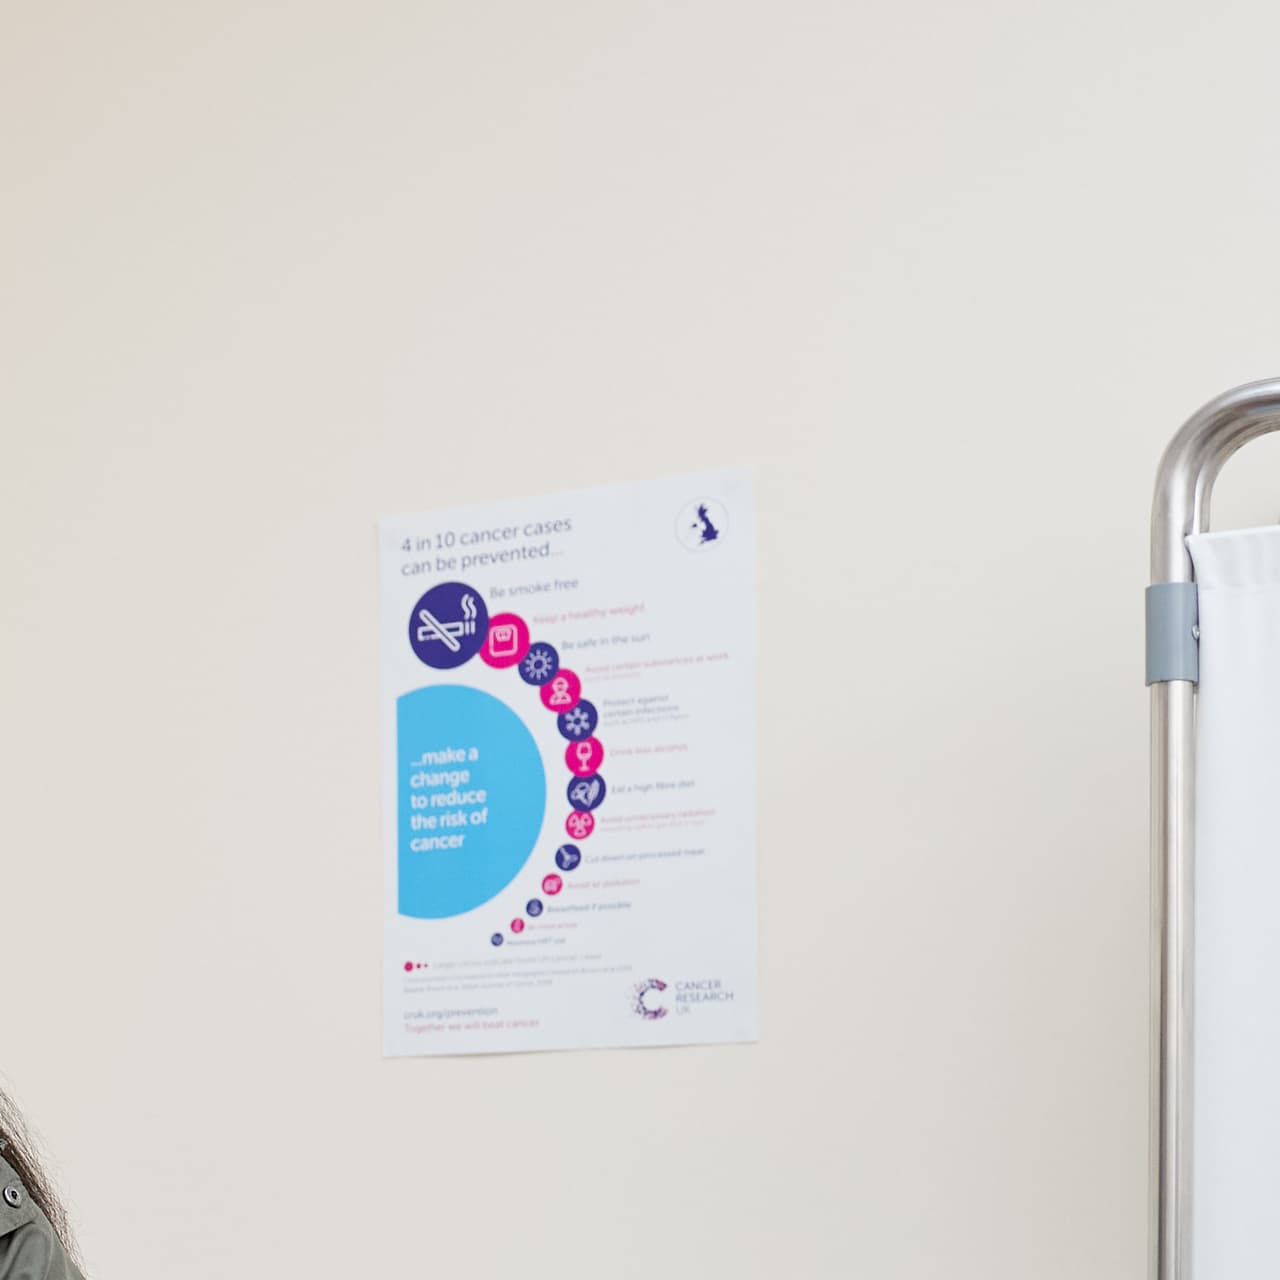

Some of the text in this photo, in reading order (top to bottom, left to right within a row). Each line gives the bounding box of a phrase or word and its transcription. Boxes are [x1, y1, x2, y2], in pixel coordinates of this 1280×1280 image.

[401, 517, 573, 552] 4 in 10 cancer cases
[400, 560, 432, 577] can
[435, 556, 457, 572] be
[489, 578, 579, 599] Be smoke free
[467, 746, 479, 762] a
[409, 769, 471, 789] change
[410, 788, 488, 810] to reduce
[410, 806, 489, 831] the risk of
[409, 833, 466, 853] cancer
[674, 979, 721, 991] CANCER
[675, 991, 734, 1003] RESEARCH
